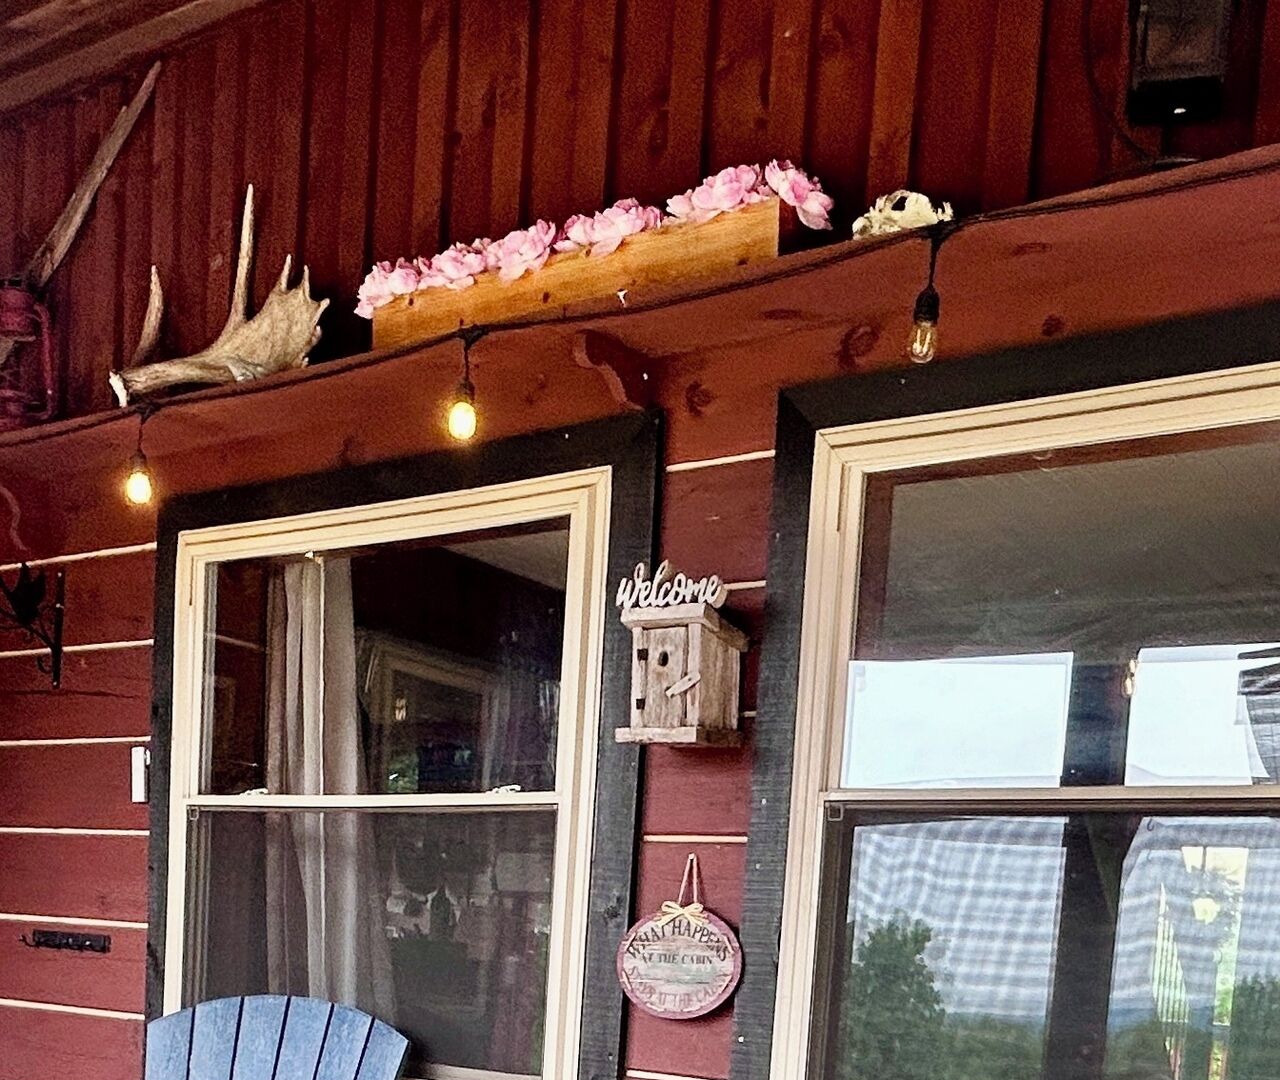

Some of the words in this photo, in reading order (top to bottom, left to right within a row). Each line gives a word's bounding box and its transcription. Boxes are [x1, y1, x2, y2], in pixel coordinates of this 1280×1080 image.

[672, 919, 730, 962] HAPPENS
[657, 952, 679, 964] THE
[681, 953, 713, 965] CABIN
